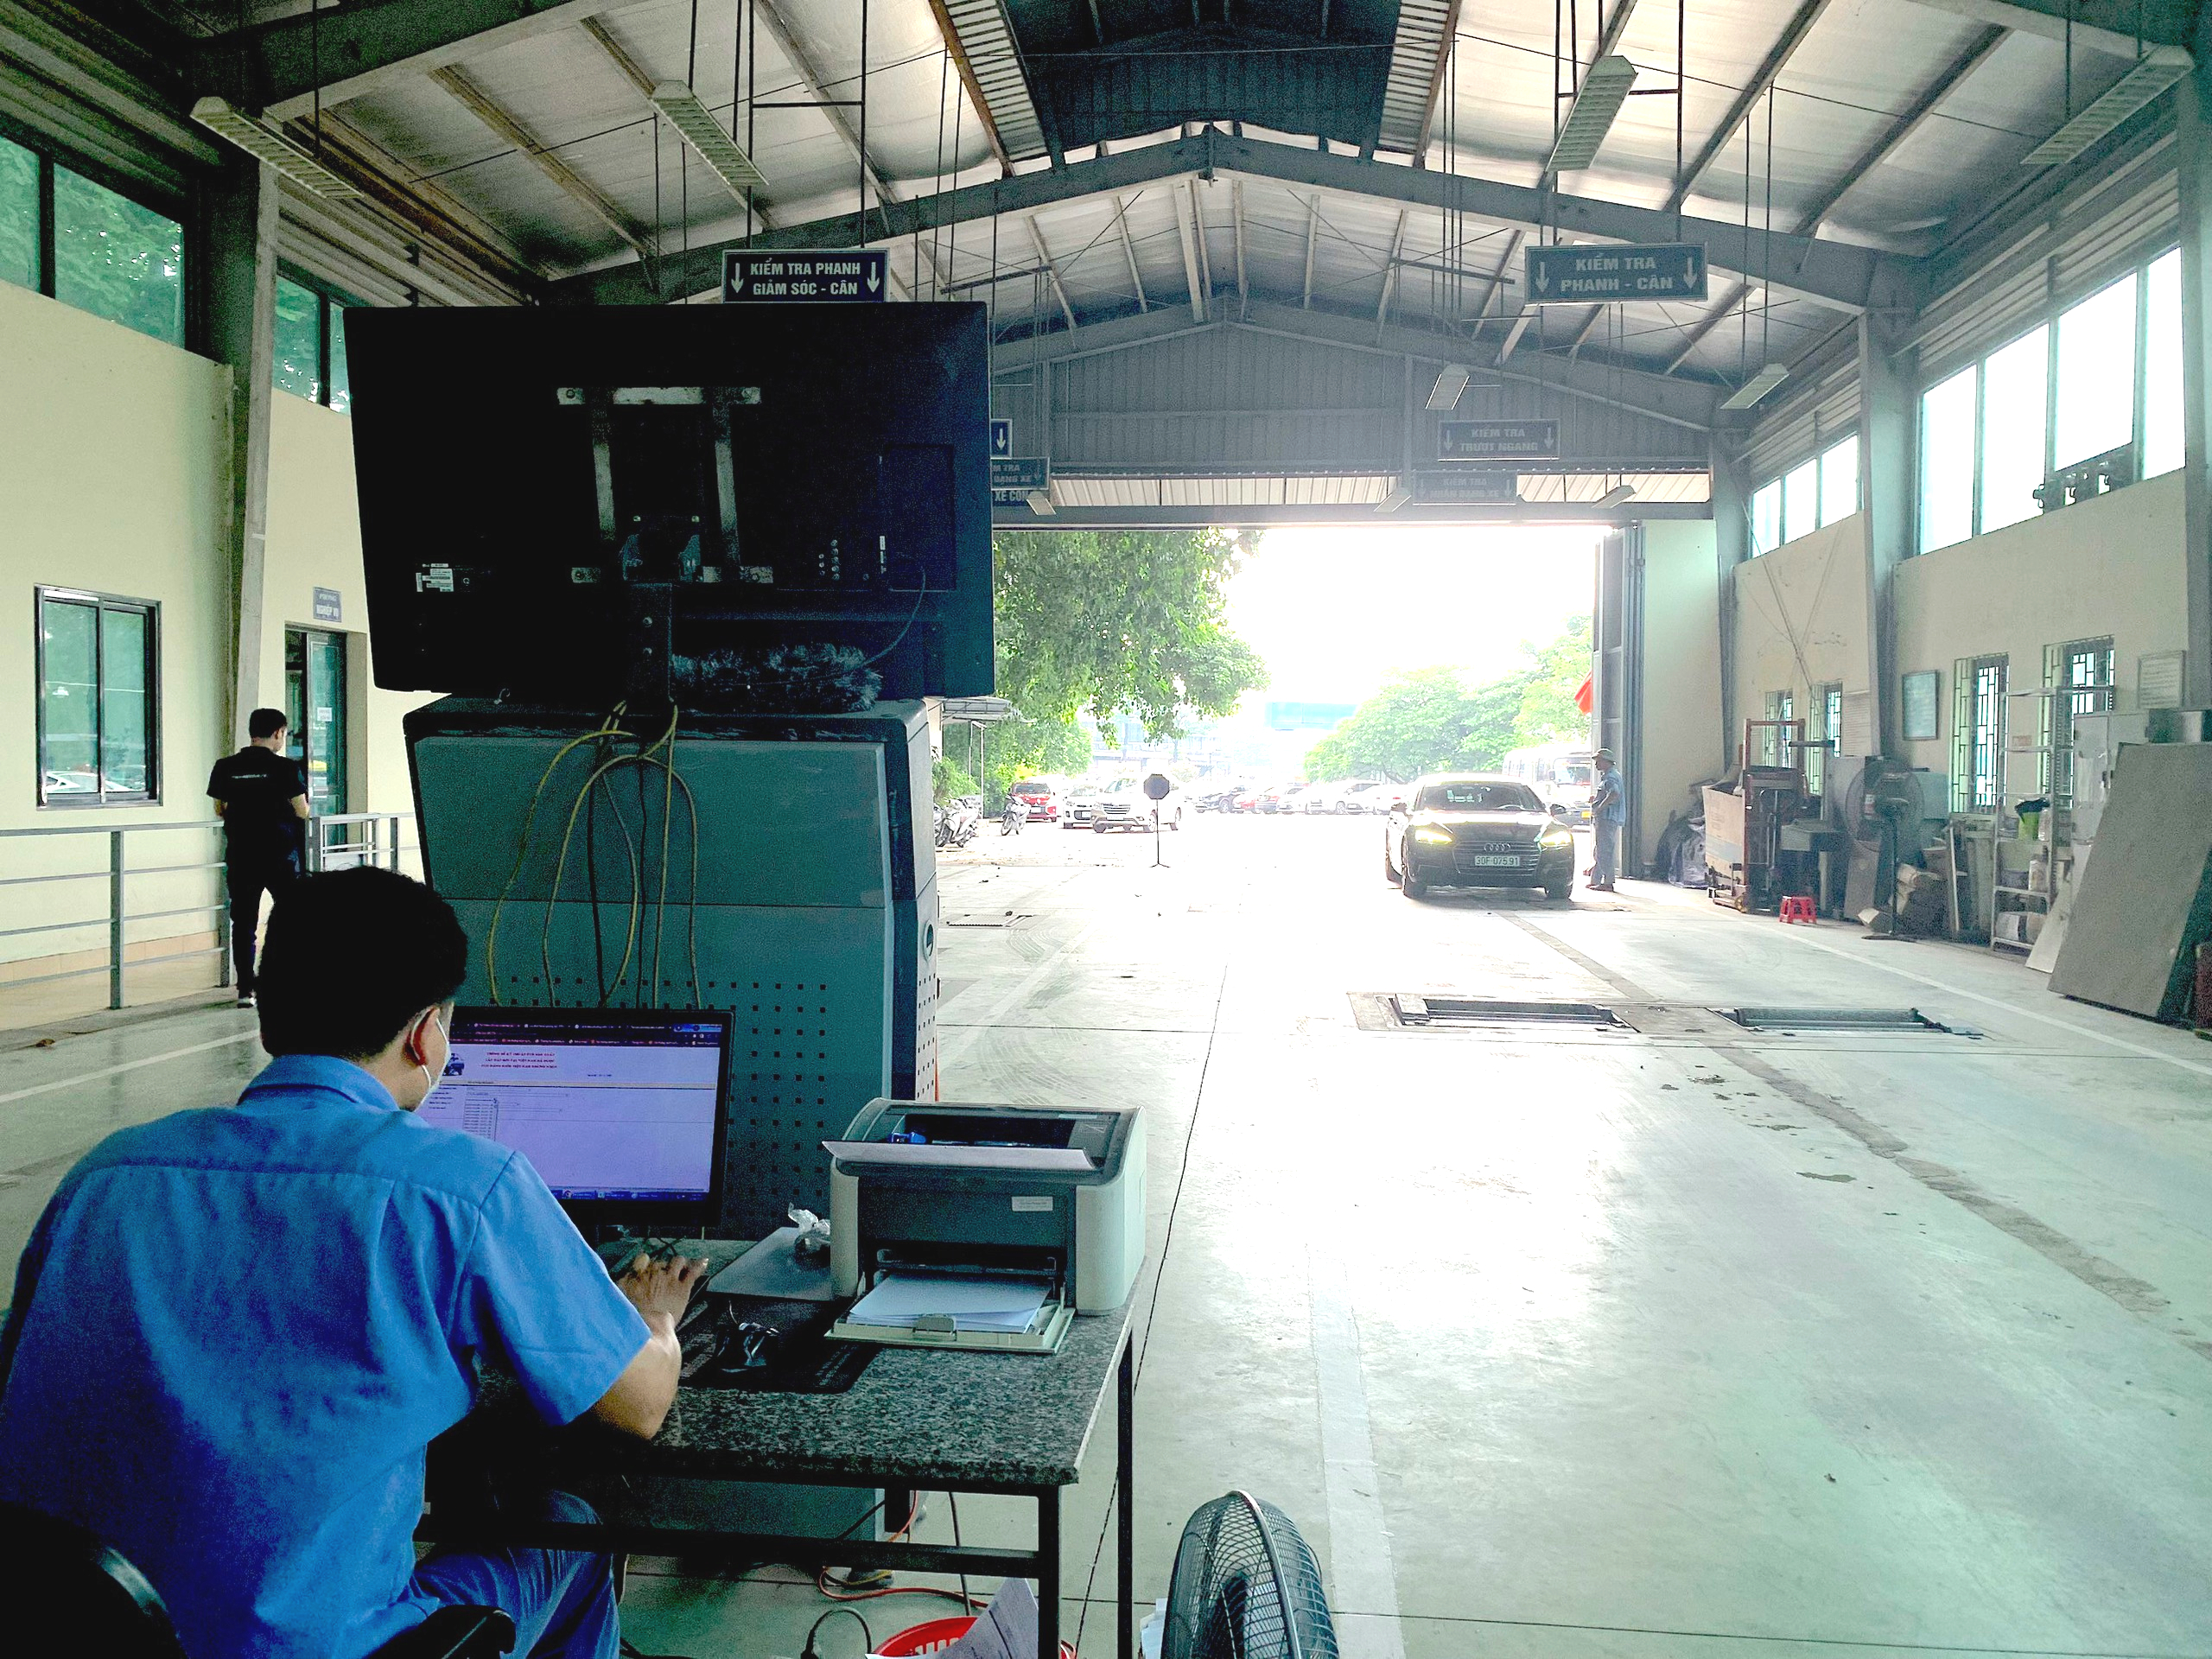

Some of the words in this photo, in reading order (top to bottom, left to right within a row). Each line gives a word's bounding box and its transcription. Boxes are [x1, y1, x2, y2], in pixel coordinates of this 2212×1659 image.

[750, 257, 783, 275] KIỂM
[787, 263, 811, 275] TRA
[816, 263, 861, 275] PHANH
[1624, 257, 1656, 270] TRA
[753, 279, 786, 295] GIẢM
[791, 280, 817, 295] SÓC
[830, 280, 858, 295] CÂN
[1560, 278, 1619, 292] PHANH
